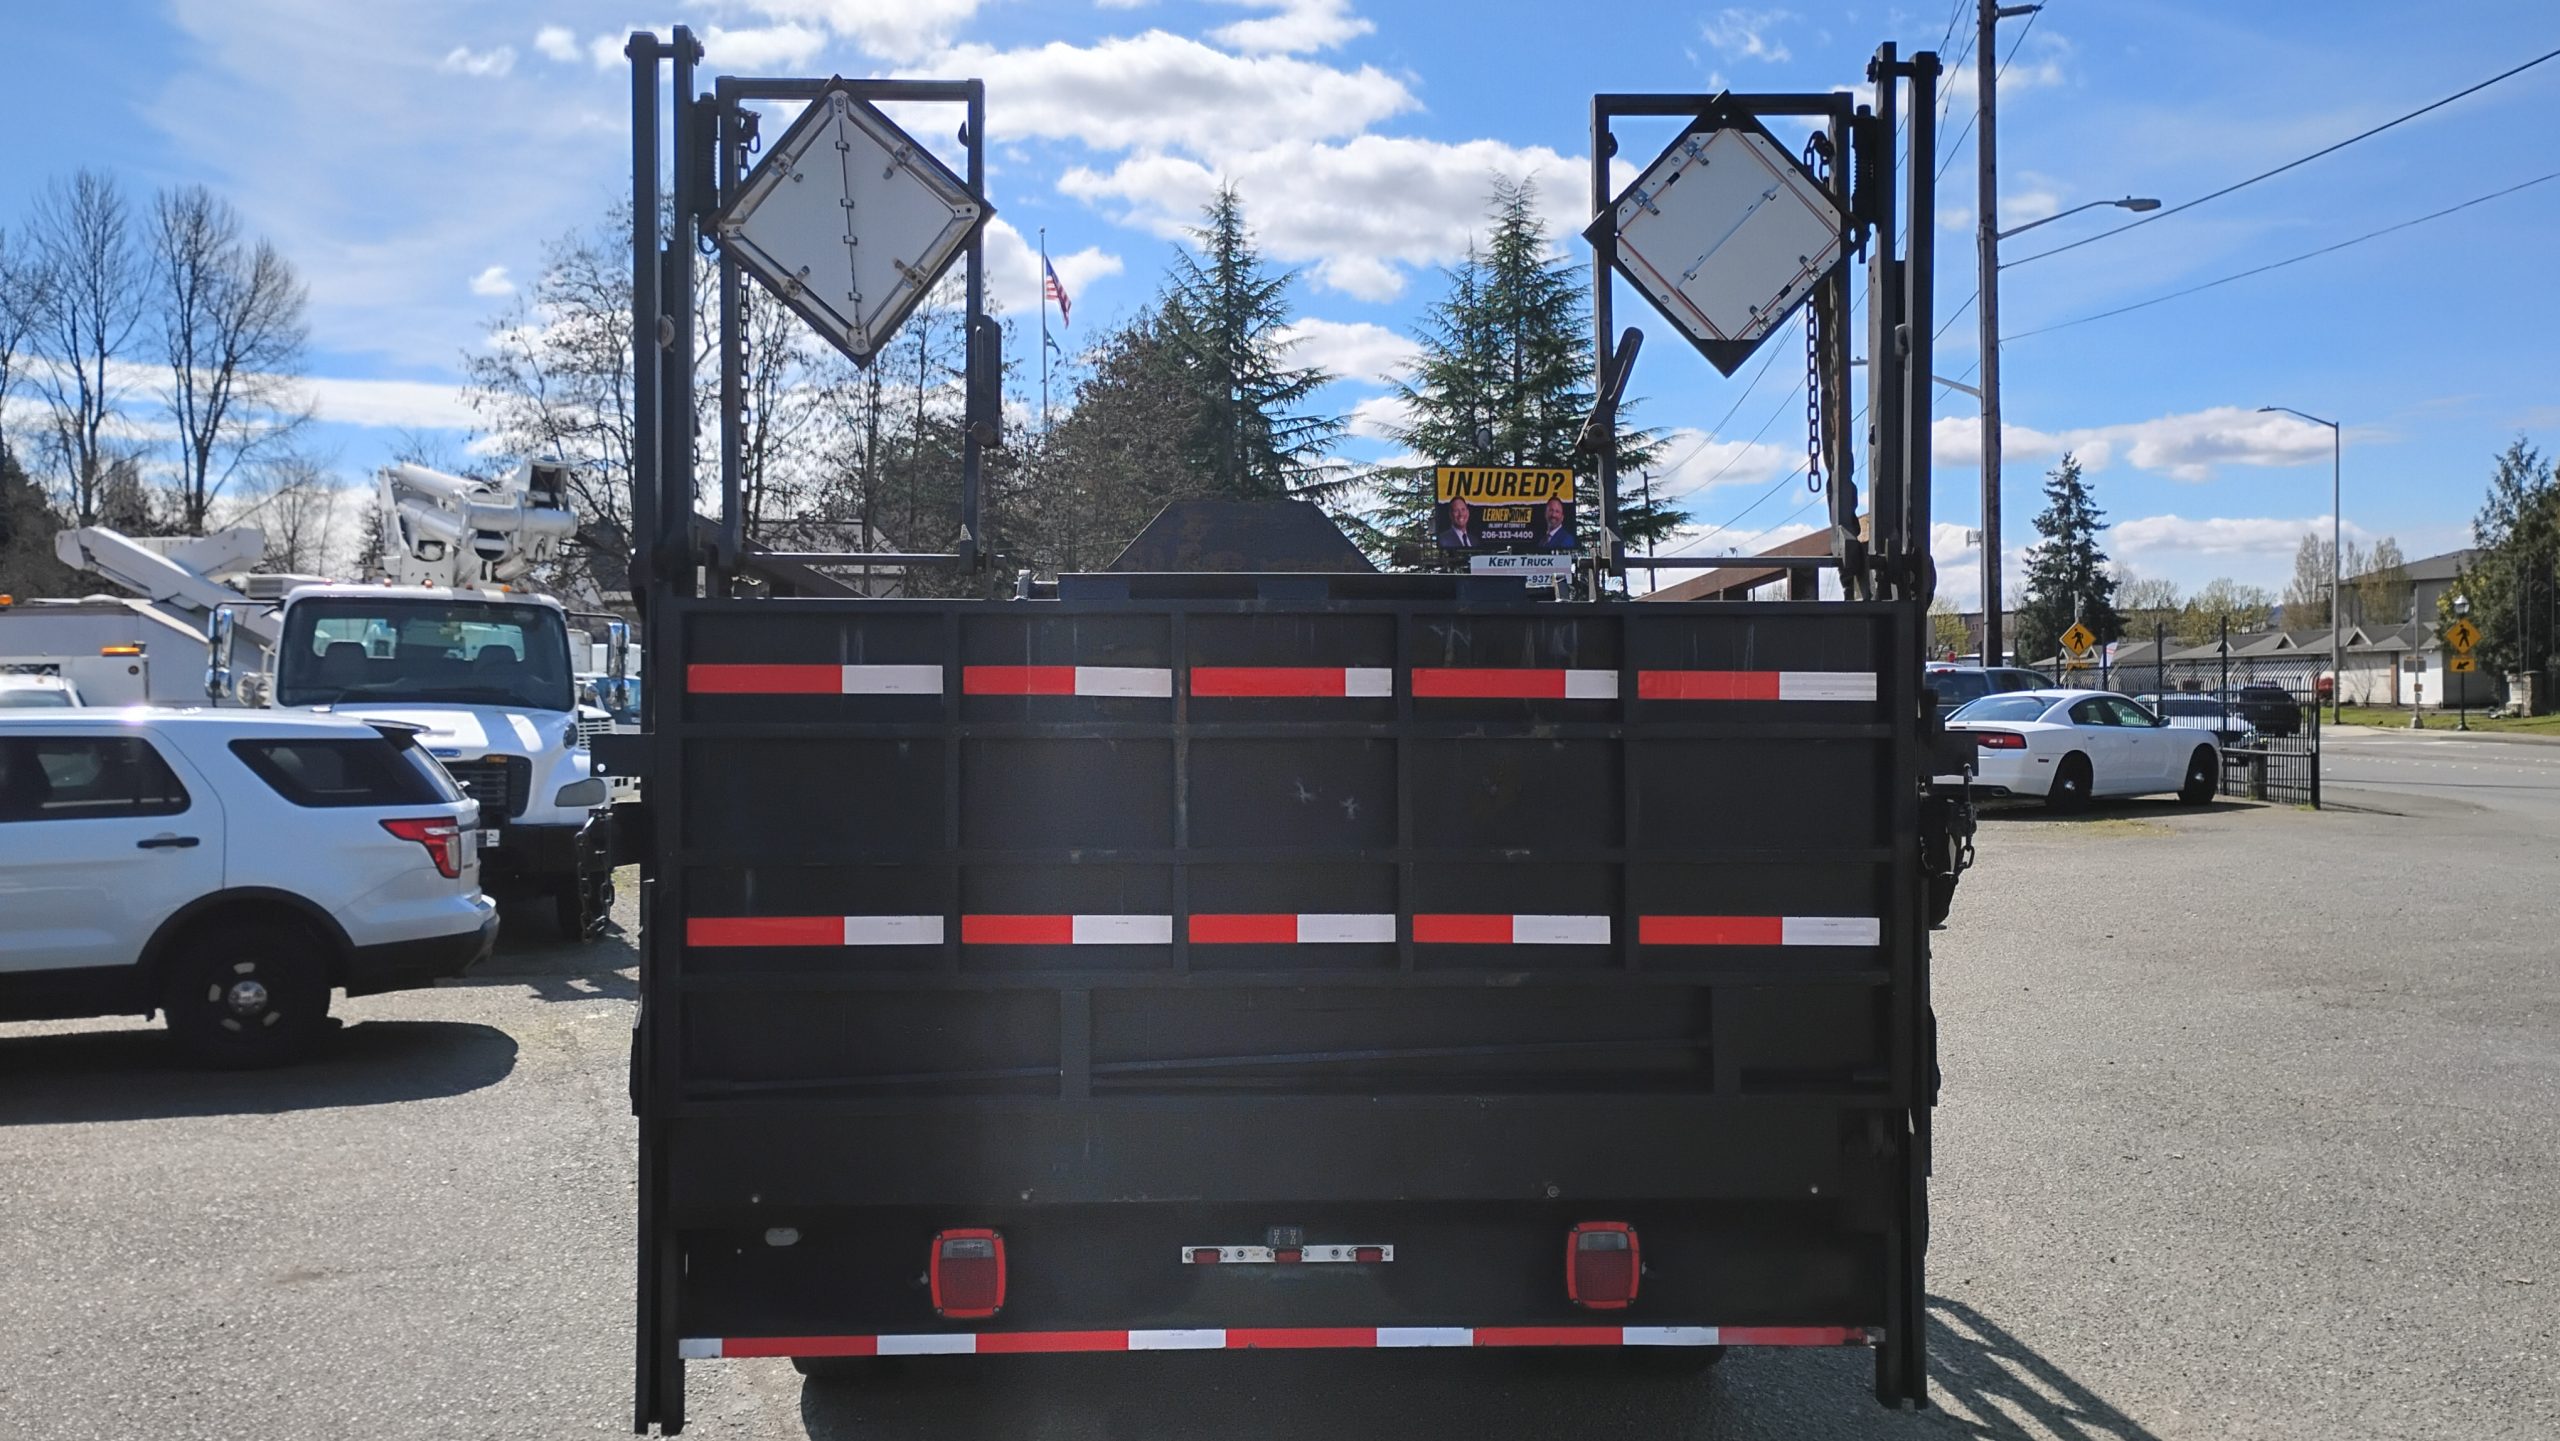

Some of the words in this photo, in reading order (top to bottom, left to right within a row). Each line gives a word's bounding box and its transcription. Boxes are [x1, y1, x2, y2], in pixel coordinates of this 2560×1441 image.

[1446, 471, 1565, 497] INJURED?
[1481, 530, 1534, 540] 206-333-4400
[1488, 556, 1517, 567] KENT
[1520, 556, 1554, 567] TRUCK
